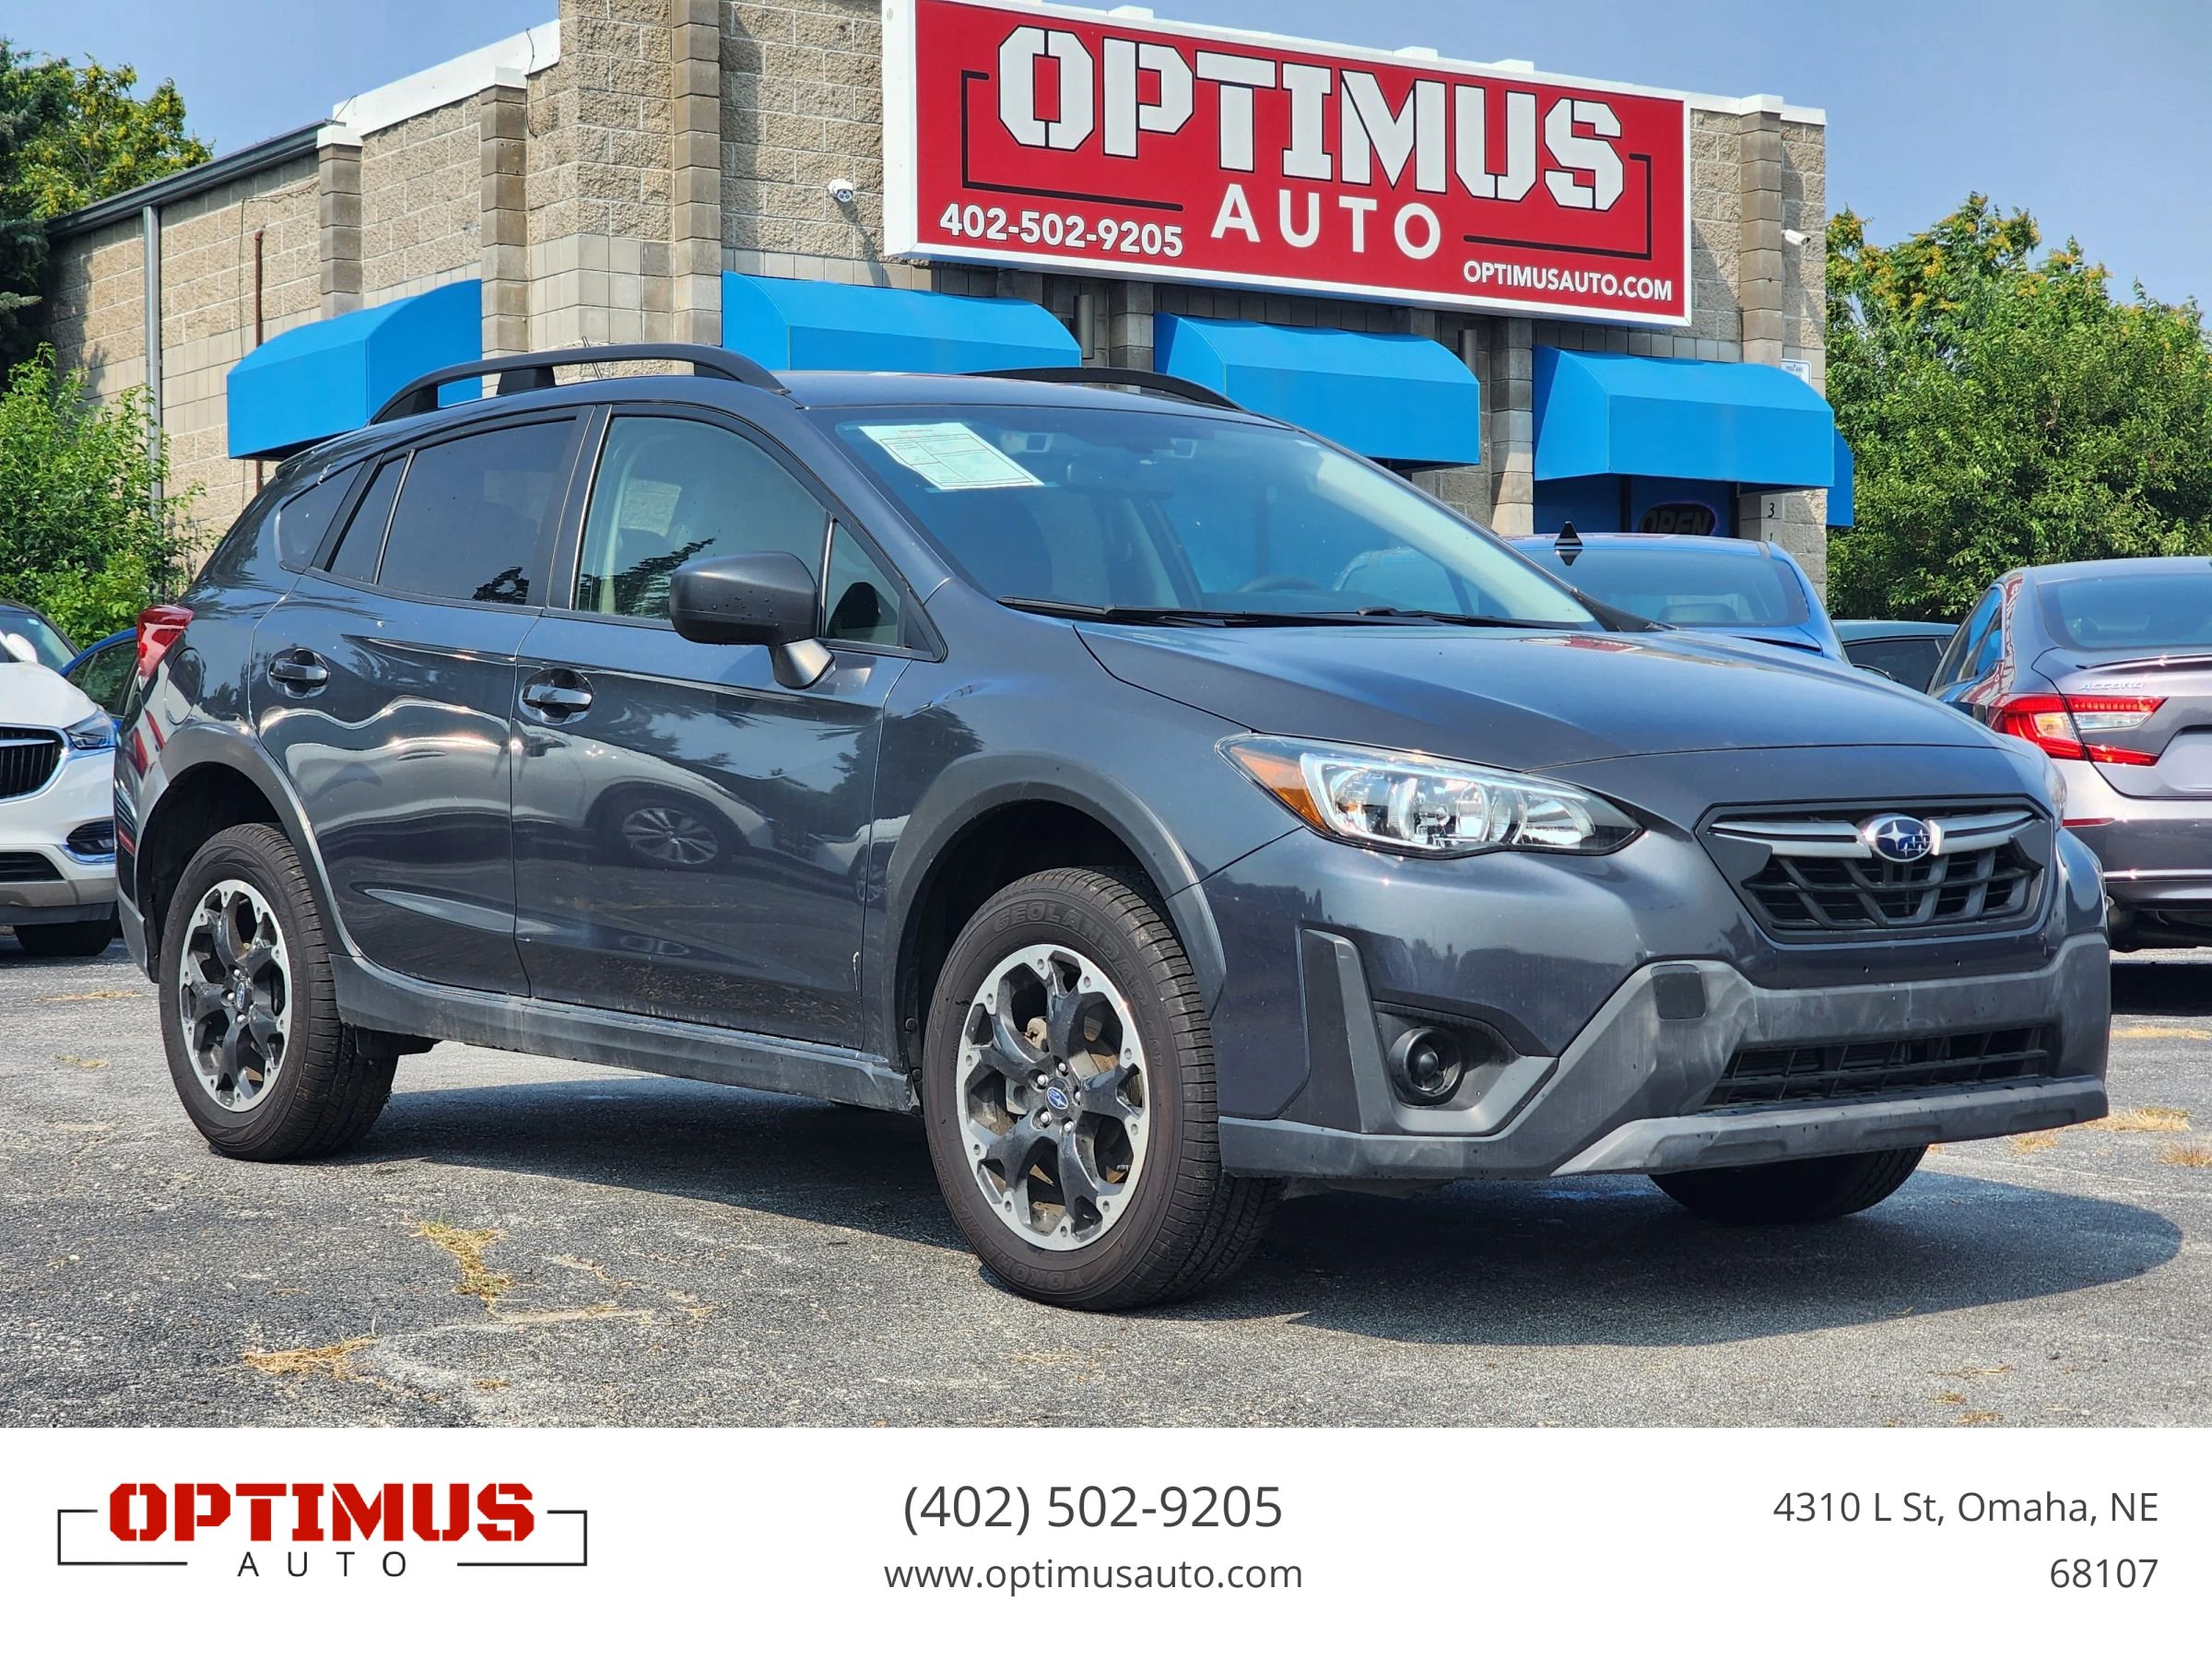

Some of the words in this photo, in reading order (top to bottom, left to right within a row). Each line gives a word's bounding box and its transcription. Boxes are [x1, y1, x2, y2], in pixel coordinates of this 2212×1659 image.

[998, 25, 1625, 211] OPTIMUS
[939, 203, 1184, 258] 402-502-9205
[1210, 182, 1441, 260] AUTO
[1463, 260, 1673, 301] OPTIMUSAUTO.COM
[1640, 511, 1712, 535] OPEN
[1768, 502, 1775, 518] 3
